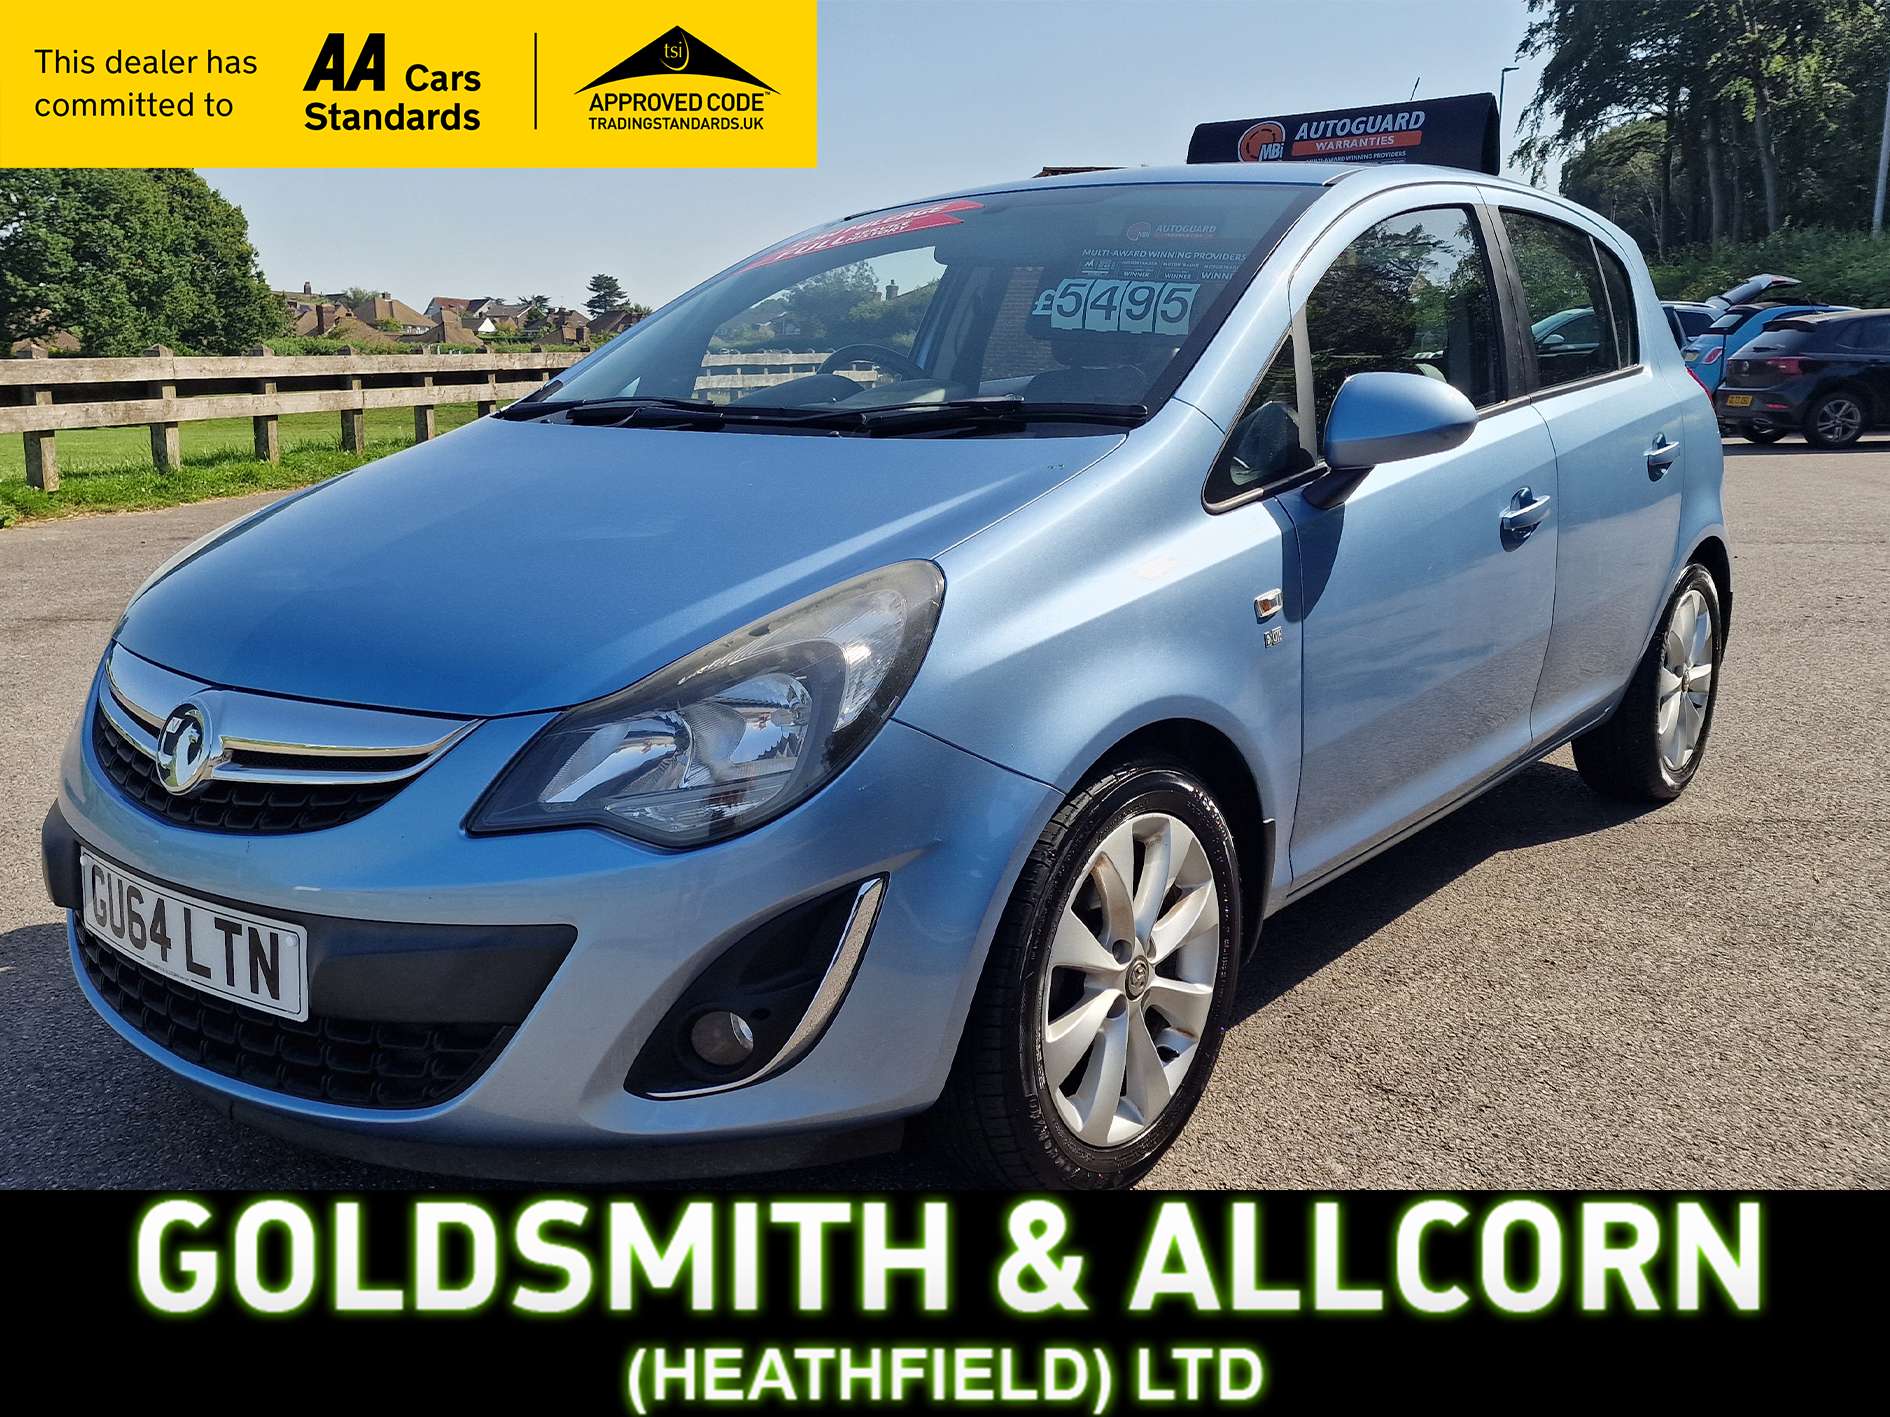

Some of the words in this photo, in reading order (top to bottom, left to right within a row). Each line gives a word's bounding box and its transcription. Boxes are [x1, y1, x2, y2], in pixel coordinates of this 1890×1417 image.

[1295, 110, 1426, 141] AUTOGUARD
[1315, 135, 1395, 151] WARRANTIES
[1155, 223, 1217, 233] AUTOGUARD
[775, 234, 846, 260] FULL
[1082, 248, 1147, 257] MULTI-AWARD
[1148, 250, 1192, 259] WINNING
[1193, 251, 1247, 261] PROVIDERS
[1032, 282, 1195, 324] £5495
[91, 863, 172, 963] GU64
[183, 906, 280, 1001] LTN
